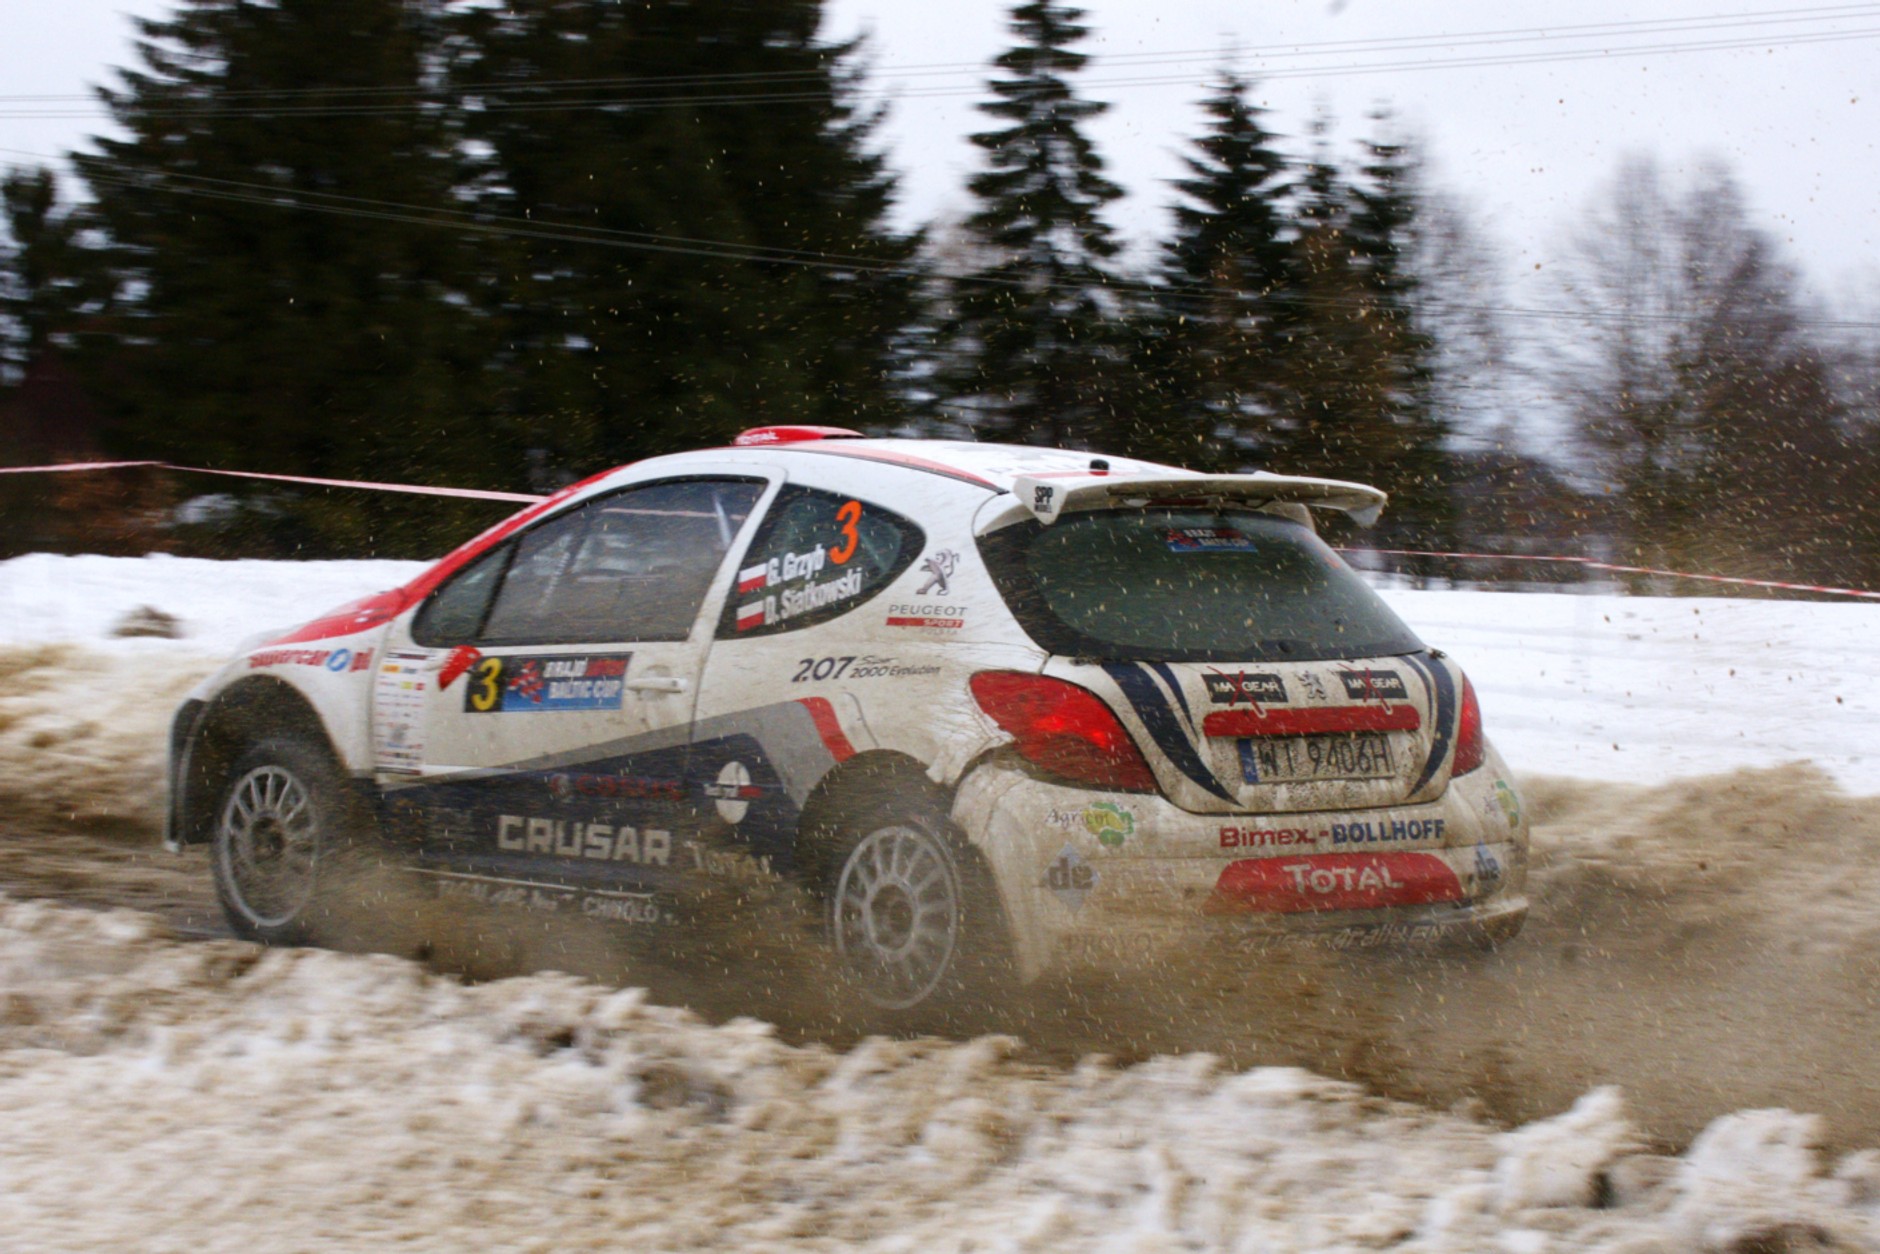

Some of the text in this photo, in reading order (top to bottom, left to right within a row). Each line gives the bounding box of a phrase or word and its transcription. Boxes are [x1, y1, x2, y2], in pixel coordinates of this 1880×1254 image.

[829, 500, 862, 565] 3
[766, 543, 825, 587] G. Grzyb
[781, 567, 862, 619] Siatkowski
[888, 604, 967, 616] PEUGEOT
[924, 619, 962, 629] SPORT
[471, 657, 501, 711] 3
[792, 656, 857, 682] 207
[850, 666, 889, 678] 2000
[548, 679, 621, 699] BALTIC CUP
[1307, 737, 1390, 775] 9406H
[497, 814, 672, 866] CRUSAR
[1283, 863, 1404, 894] TOTAL
